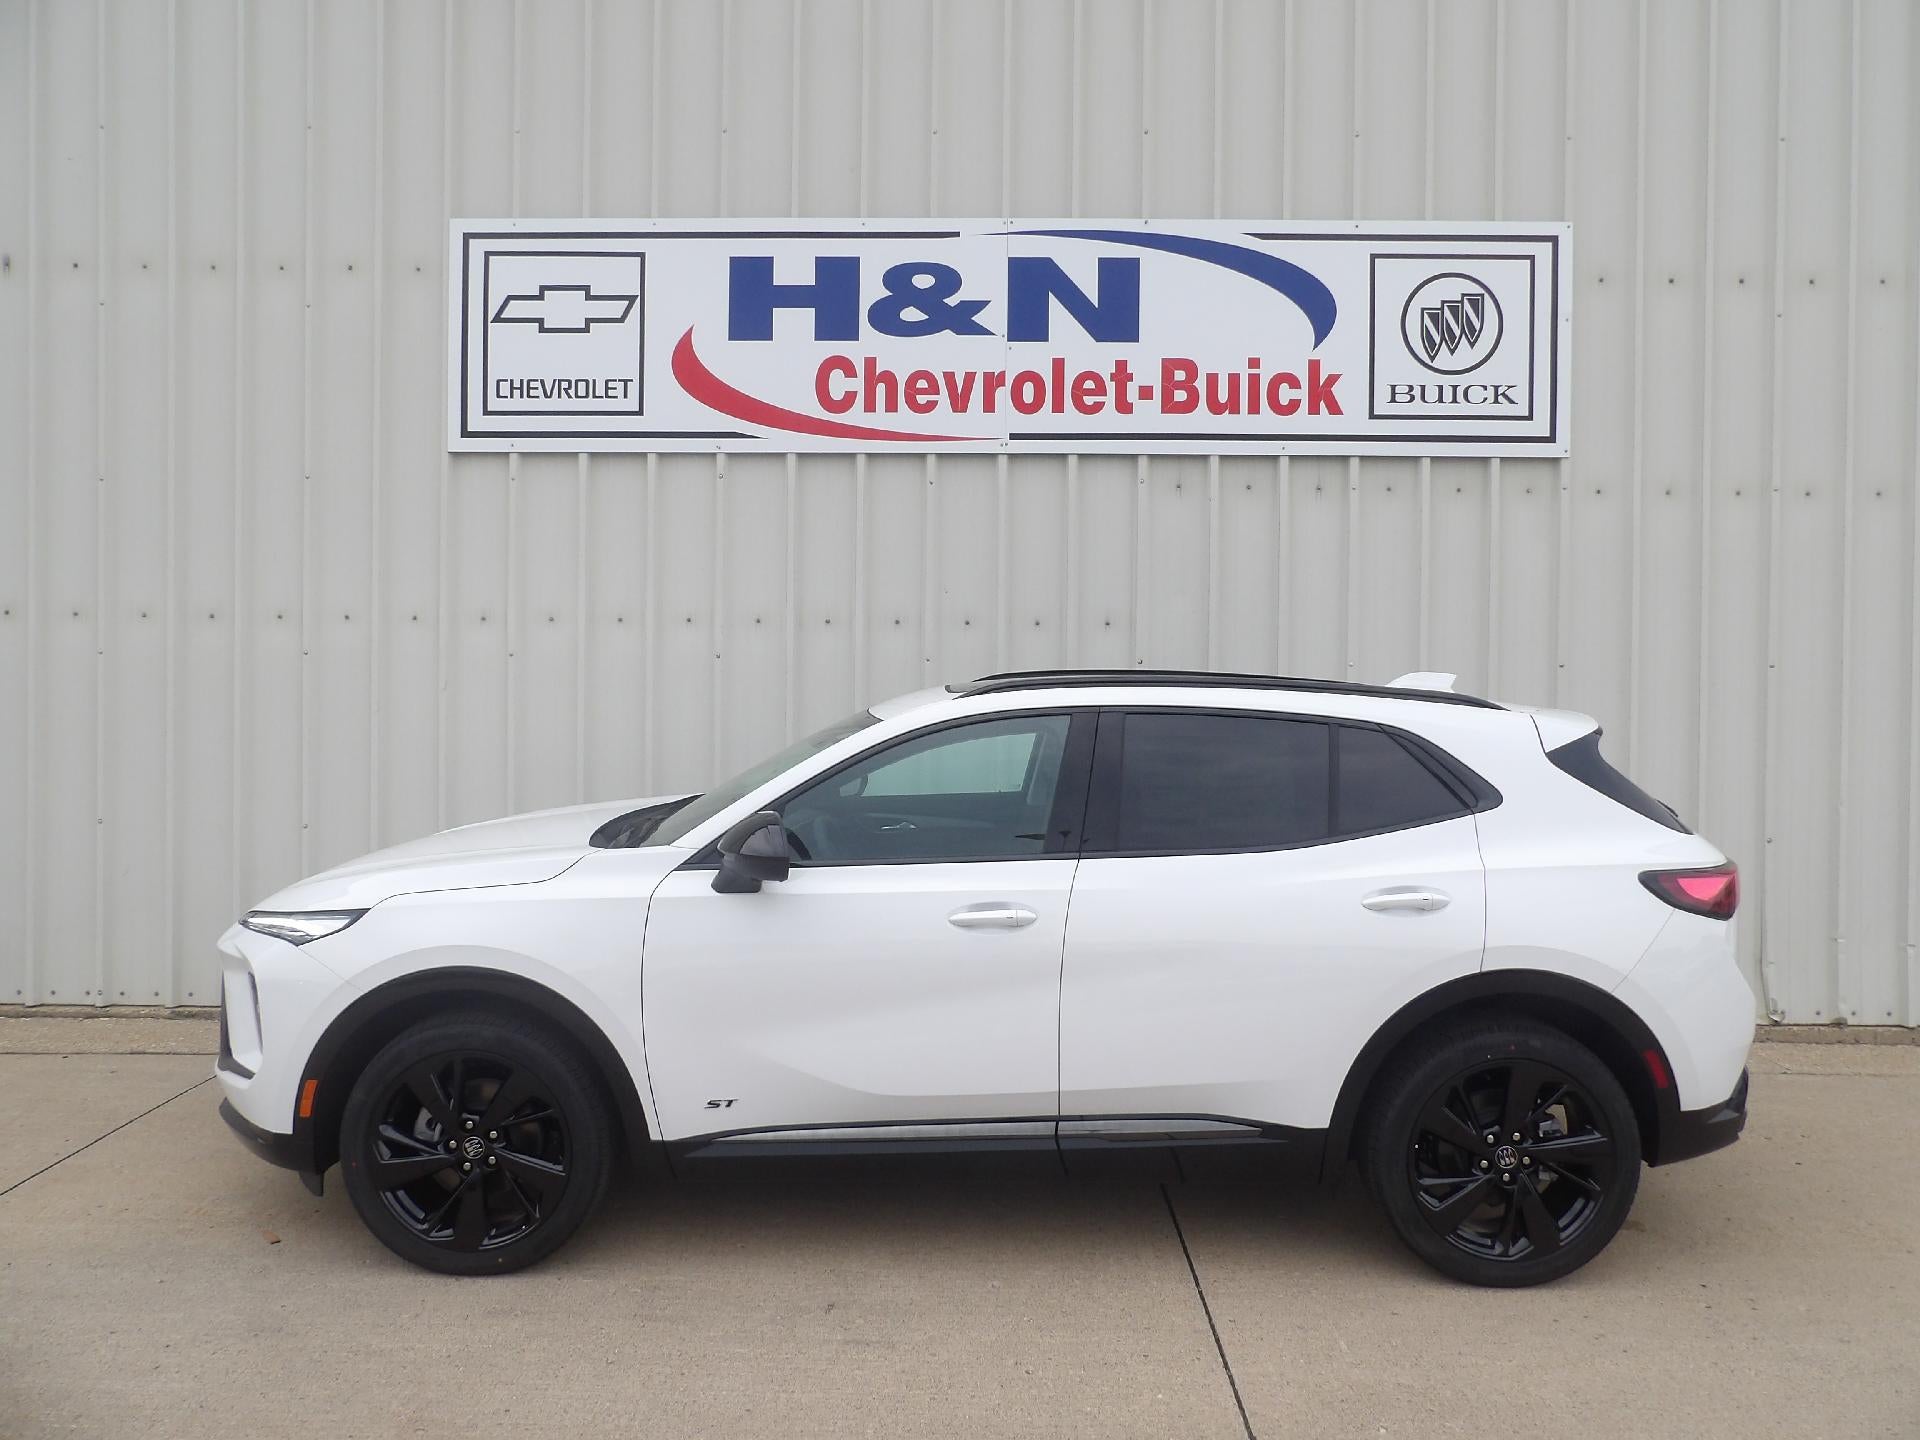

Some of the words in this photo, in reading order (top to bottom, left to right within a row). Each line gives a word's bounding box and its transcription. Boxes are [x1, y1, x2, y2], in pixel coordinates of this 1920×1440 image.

[729, 257, 1140, 342] H&N
[495, 378, 634, 400] CHEVROLET
[815, 355, 1343, 416] Chevrolet-Buick
[1386, 383, 1519, 405] BUICK
[704, 1098, 739, 1110] ST
